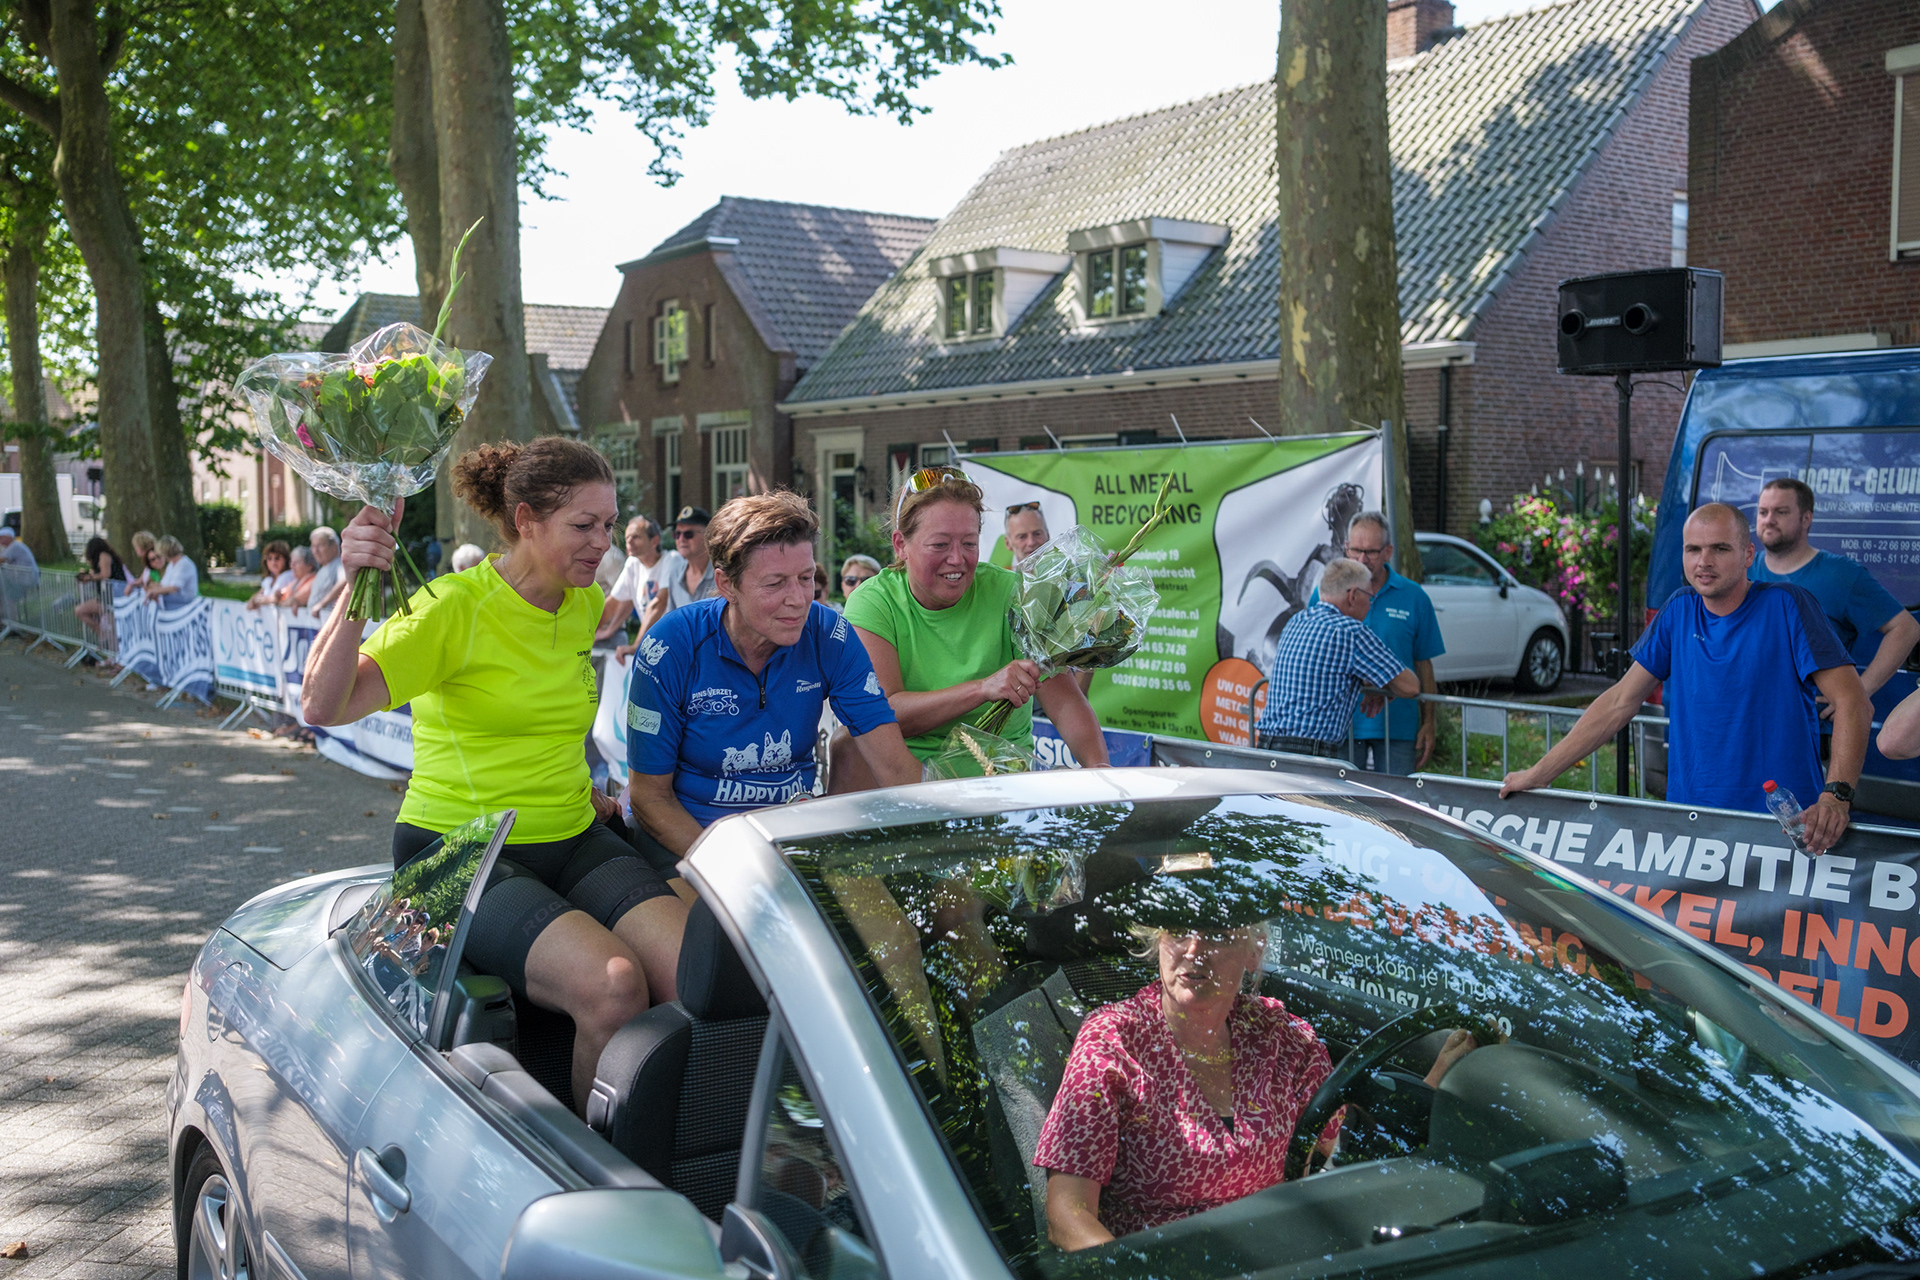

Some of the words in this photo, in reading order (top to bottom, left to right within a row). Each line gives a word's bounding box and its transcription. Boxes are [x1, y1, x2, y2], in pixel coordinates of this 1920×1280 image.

[1094, 475, 1126, 494] ALL
[1129, 472, 1193, 494] METAL
[1863, 540, 1872, 550] 06
[1878, 540, 1888, 550] 22
[1889, 541, 1899, 551] 66
[1900, 541, 1910, 551] 99
[1169, 549, 1179, 561] 19
[1863, 552, 1881, 563] 0165
[1888, 554, 1897, 564] 51
[1900, 555, 1909, 564] 12
[1162, 679, 1175, 691] 35
[1217, 678, 1234, 694] UW
[1213, 712, 1236, 729] ZIJN
[713, 778, 778, 803] HAPPY
[1594, 828, 1857, 903] AMBITIE
[1299, 933, 1370, 970] Wanneer
[1376, 952, 1416, 982] kom
[1420, 964, 1438, 989] je
